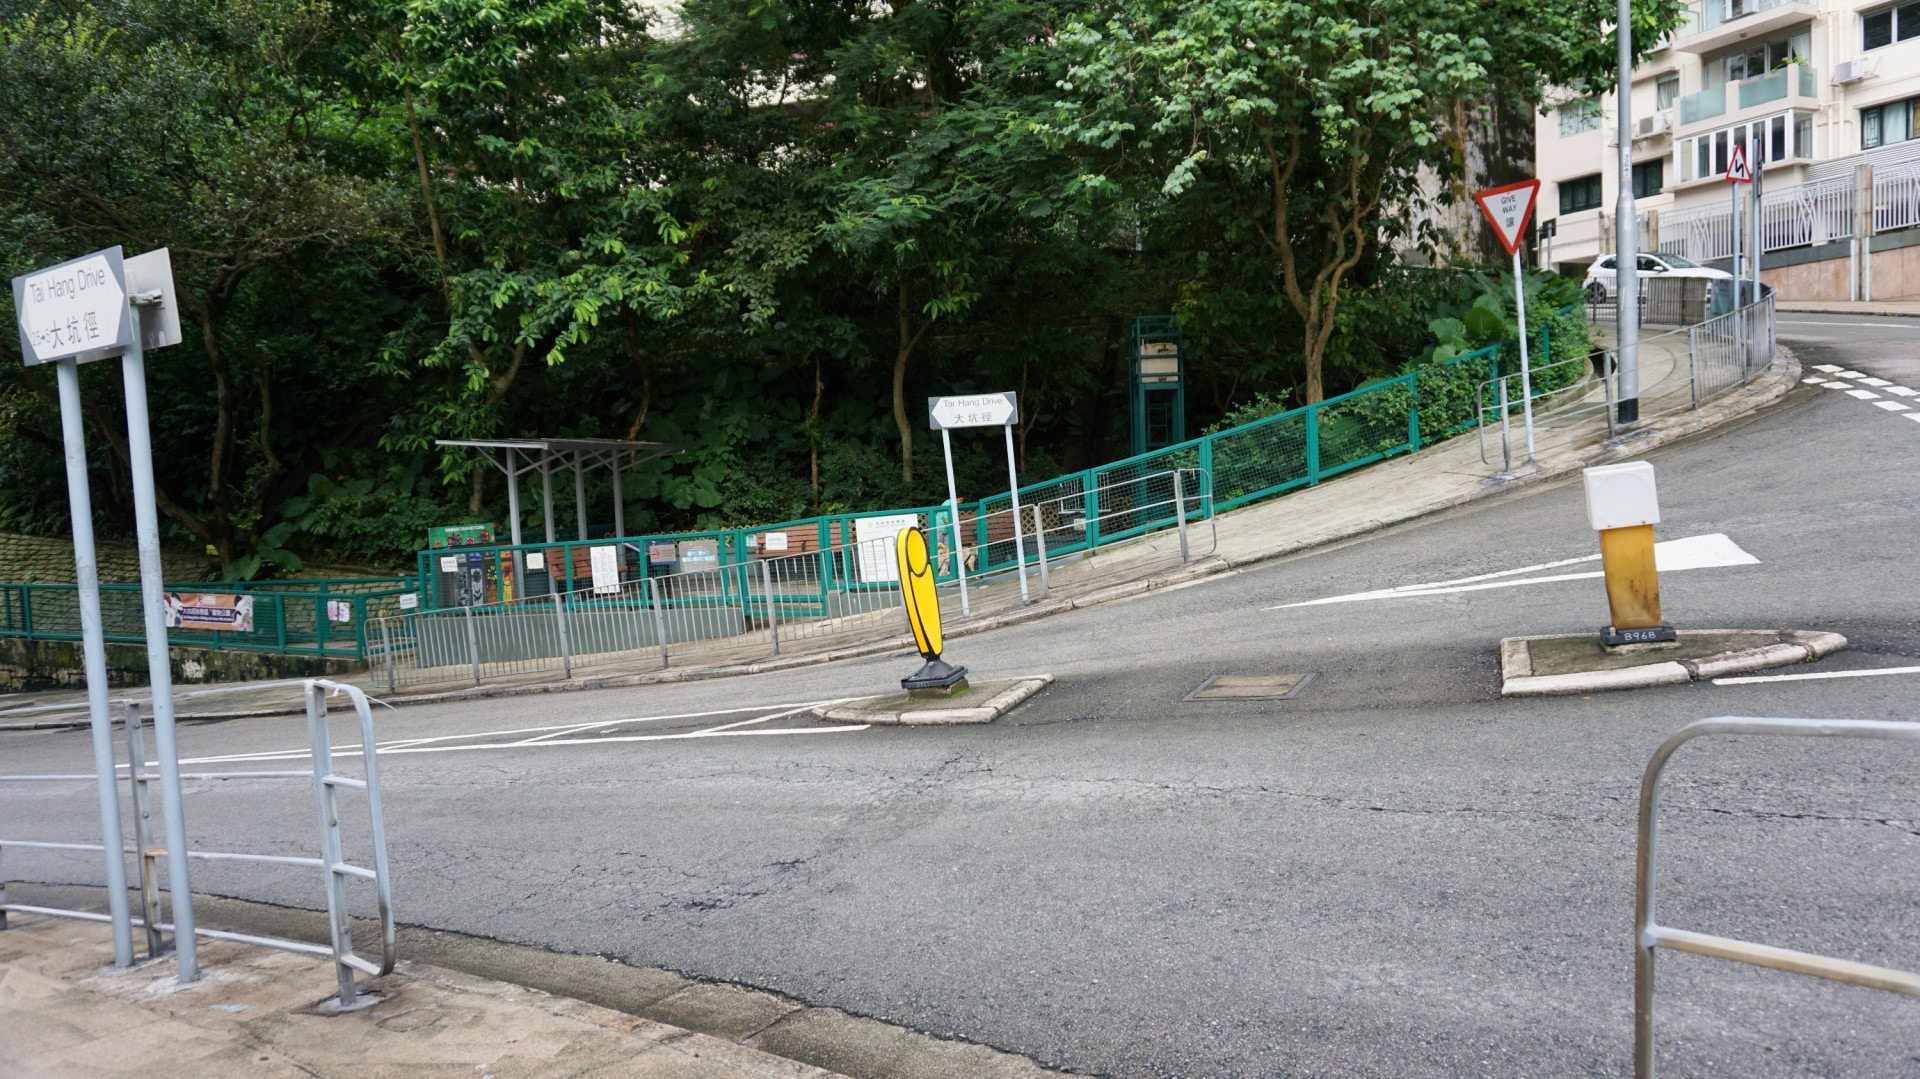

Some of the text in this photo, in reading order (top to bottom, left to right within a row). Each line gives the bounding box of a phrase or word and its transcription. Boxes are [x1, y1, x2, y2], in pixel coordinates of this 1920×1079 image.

[1501, 195, 1516, 204] GIVE
[1502, 204, 1517, 214] WAY
[29, 267, 106, 303] Tai Hang Drive
[50, 311, 100, 349] 大坑徑
[943, 397, 1003, 408] Tai Hang Drive
[954, 411, 992, 424] 大坑徑
